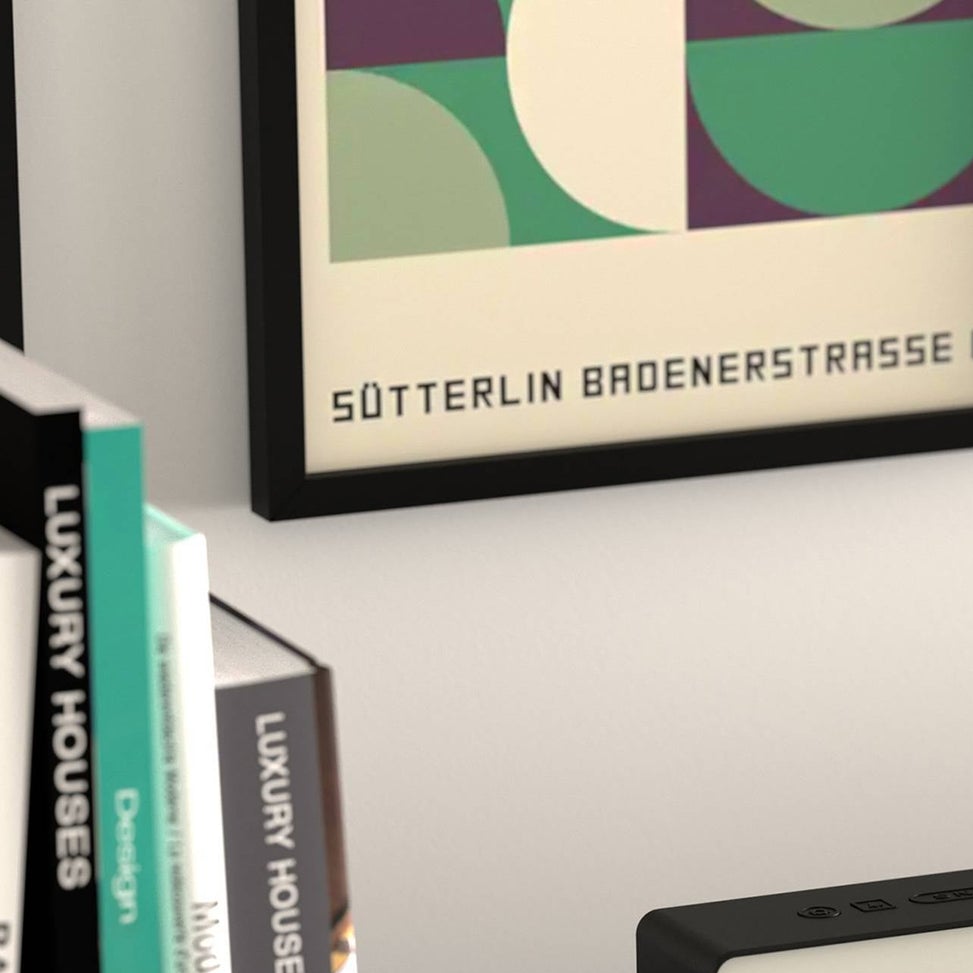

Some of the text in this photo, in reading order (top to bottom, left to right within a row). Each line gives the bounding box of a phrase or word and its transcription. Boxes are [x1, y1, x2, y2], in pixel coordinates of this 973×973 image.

[332, 369, 563, 423] SÜTTERLIN
[583, 332, 952, 398] BADENERSTRASSE
[43, 484, 92, 891] LUXURY HOUSES
[255, 711, 294, 850] LUXURY
[111, 788, 141, 925] Design
